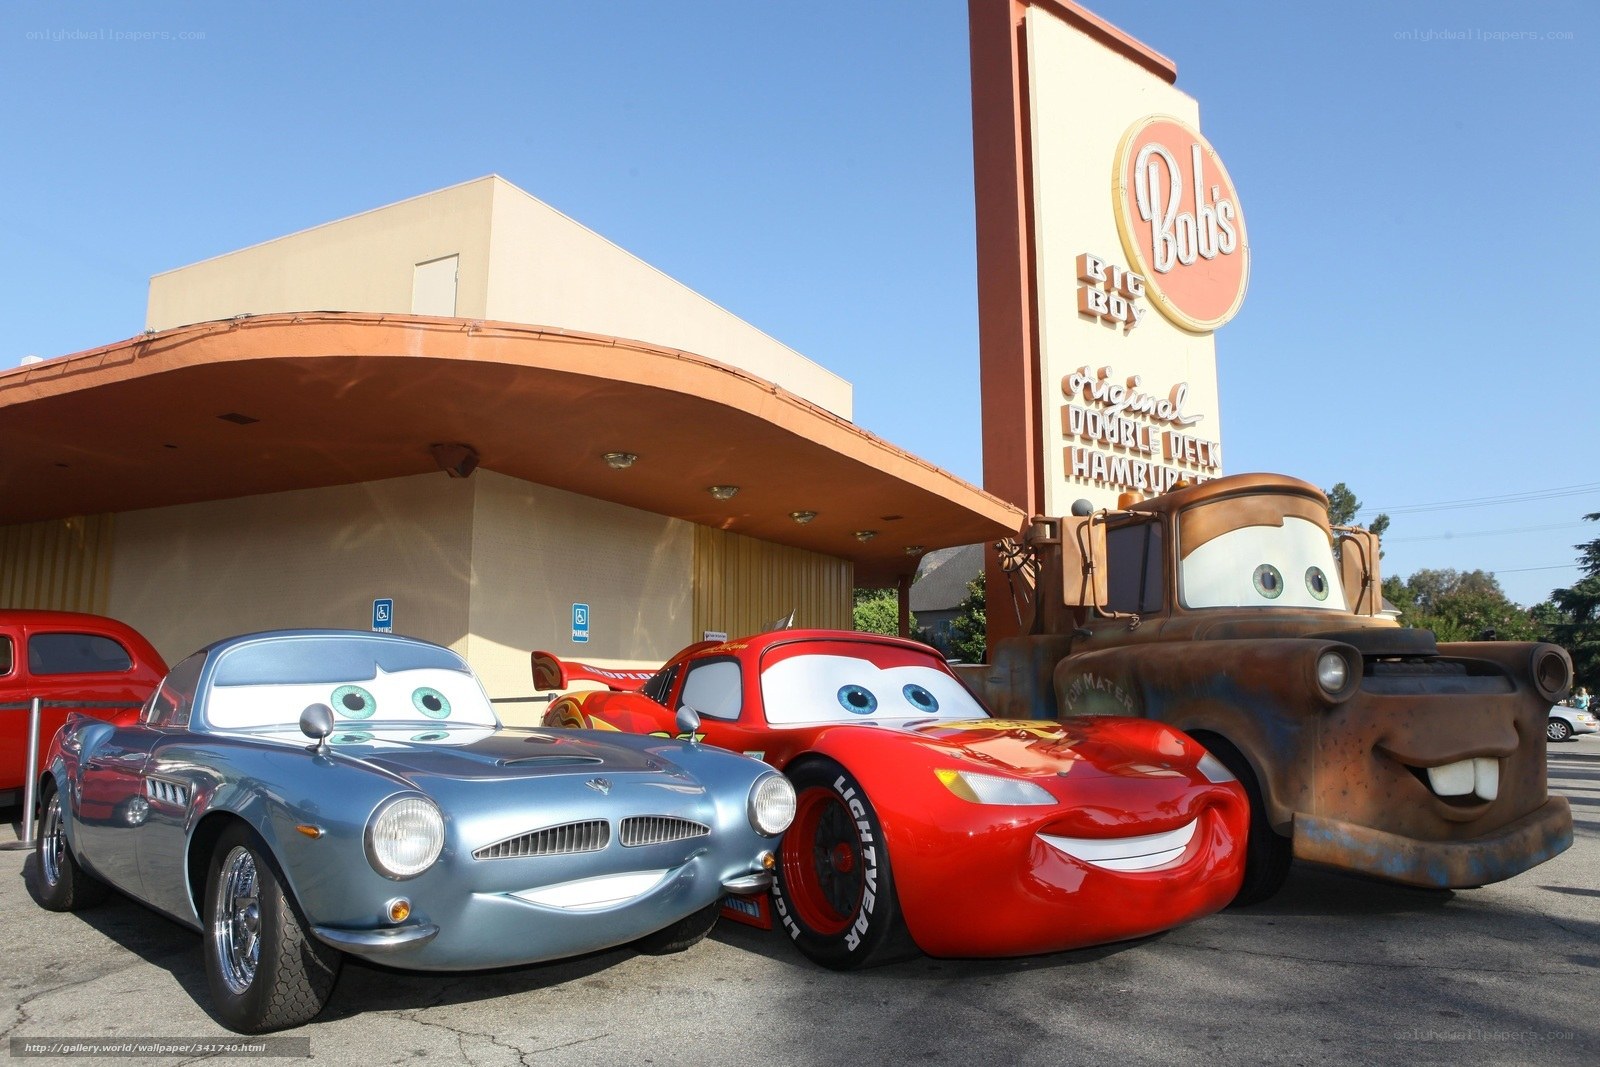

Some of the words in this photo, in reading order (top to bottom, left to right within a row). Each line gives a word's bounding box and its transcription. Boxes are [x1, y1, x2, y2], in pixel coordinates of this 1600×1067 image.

[1134, 142, 1237, 274] Bob's
[1080, 253, 1146, 299] BIG
[1080, 285, 1147, 330] BOY
[1064, 404, 1161, 456] DOUBLE
[1164, 431, 1221, 469] DECK
[1066, 446, 1217, 494] HAMBUR
[1082, 672, 1135, 712] MATER
[833, 775, 877, 952] LIGHTYEAR
